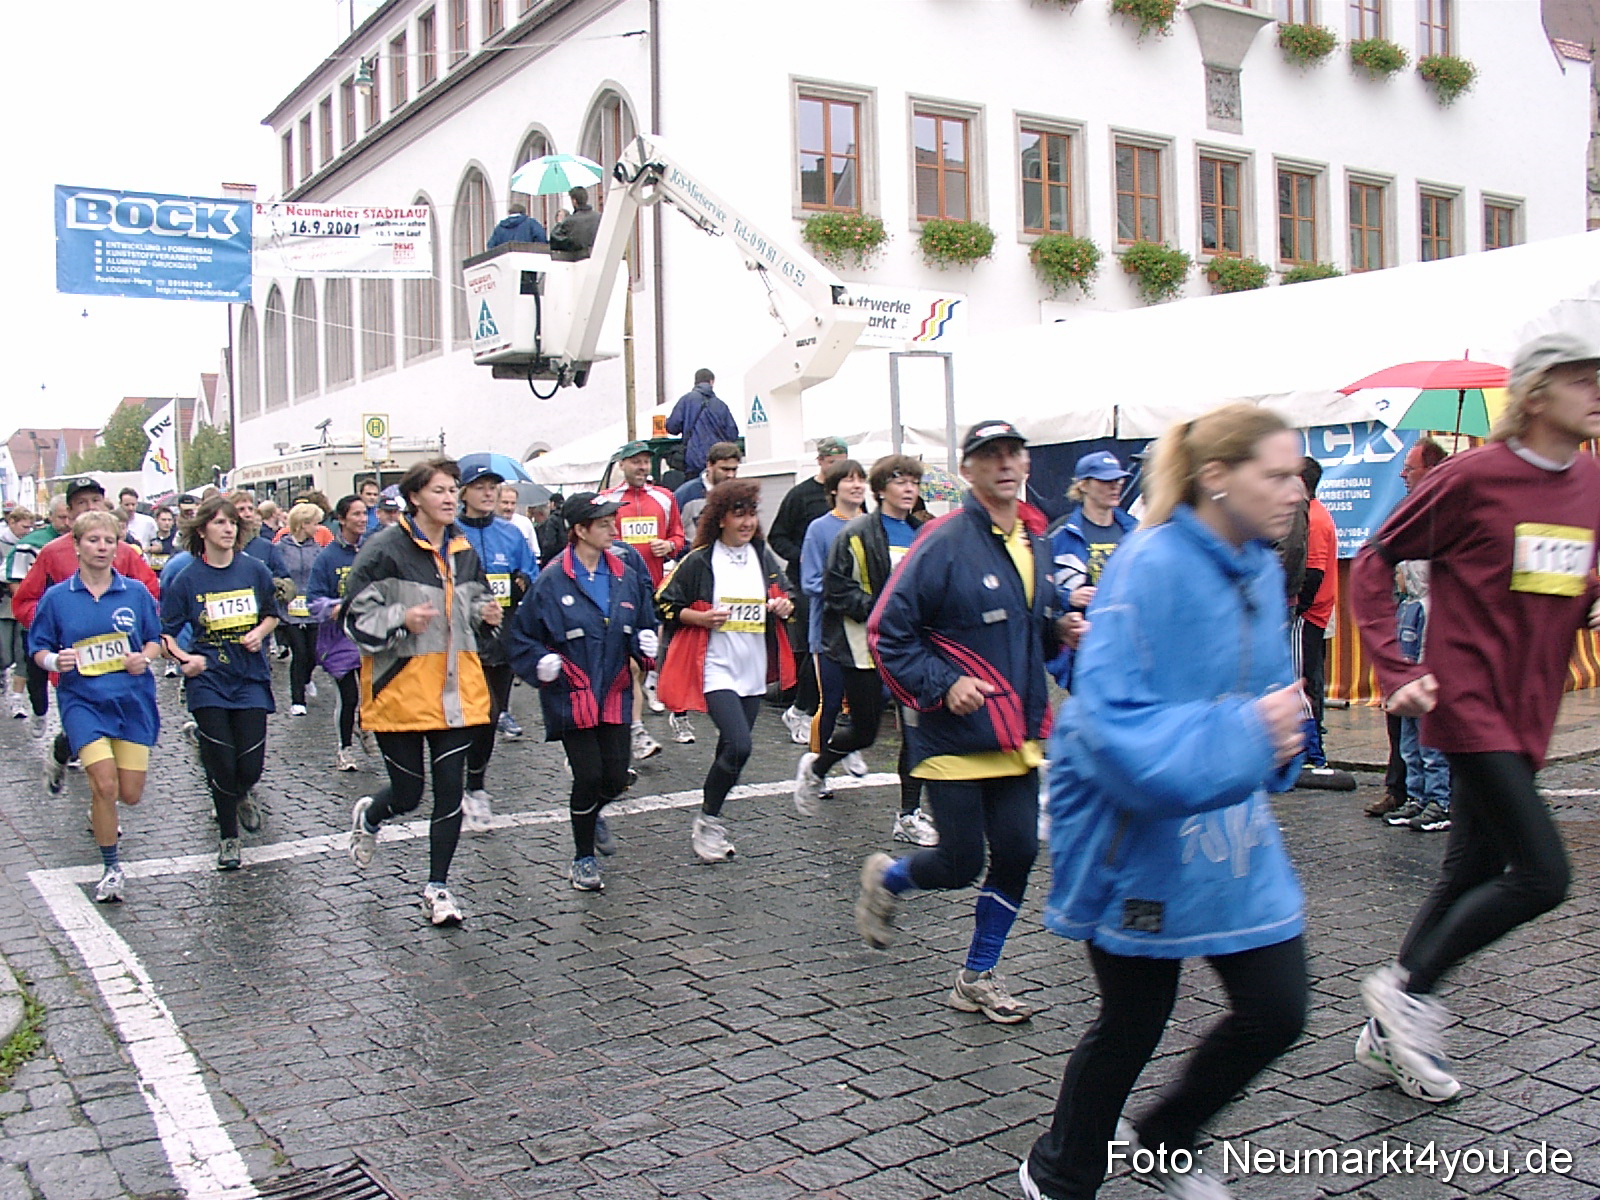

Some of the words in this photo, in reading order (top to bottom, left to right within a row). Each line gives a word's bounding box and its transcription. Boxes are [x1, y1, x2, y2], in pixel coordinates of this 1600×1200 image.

[66, 192, 240, 240] BOCK
[286, 205, 359, 219] Neumarkter
[363, 208, 428, 219] STADTLAUF
[291, 220, 360, 235] 16.9.2001
[106, 265, 141, 275] LOGISTIK
[856, 295, 911, 315] dtwerke
[868, 315, 898, 329] arkt
[1320, 477, 1371, 488] ORMENBAU
[1319, 489, 1371, 499] ARBEITUNG
[1323, 501, 1353, 511] GUSS
[629, 522, 654, 535] 1007
[491, 581, 505, 595] 83
[218, 597, 251, 615] 1751
[86, 640, 123, 662] 1750
